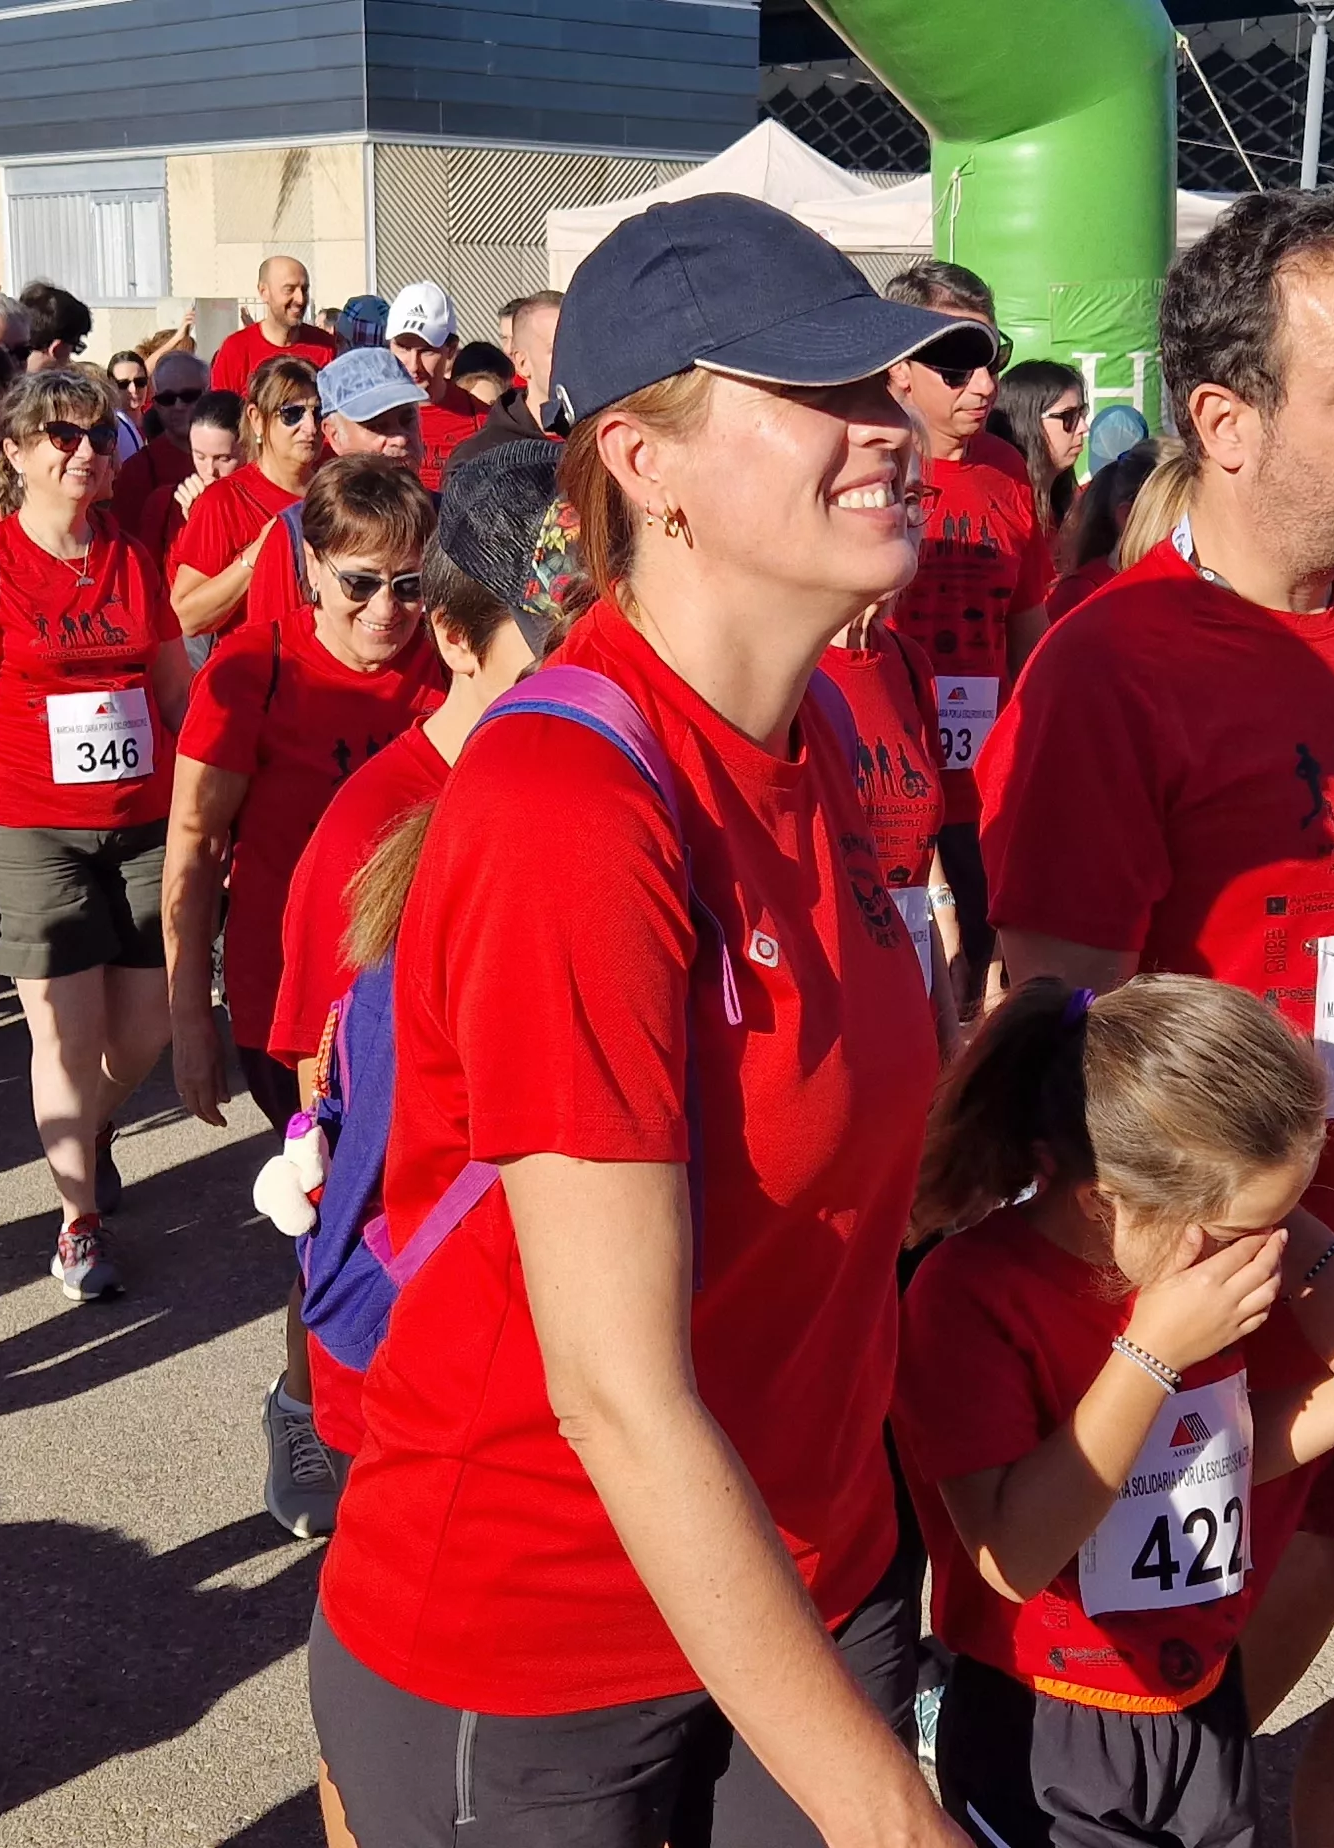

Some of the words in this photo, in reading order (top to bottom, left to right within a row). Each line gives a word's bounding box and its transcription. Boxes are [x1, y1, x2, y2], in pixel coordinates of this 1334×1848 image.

[76, 737, 140, 773] 346
[1132, 1469, 1177, 1497] SOLIDARIA
[1179, 1466, 1196, 1488] POR
[1196, 1464, 1206, 1485] LA
[1131, 1496, 1243, 1591] 422
